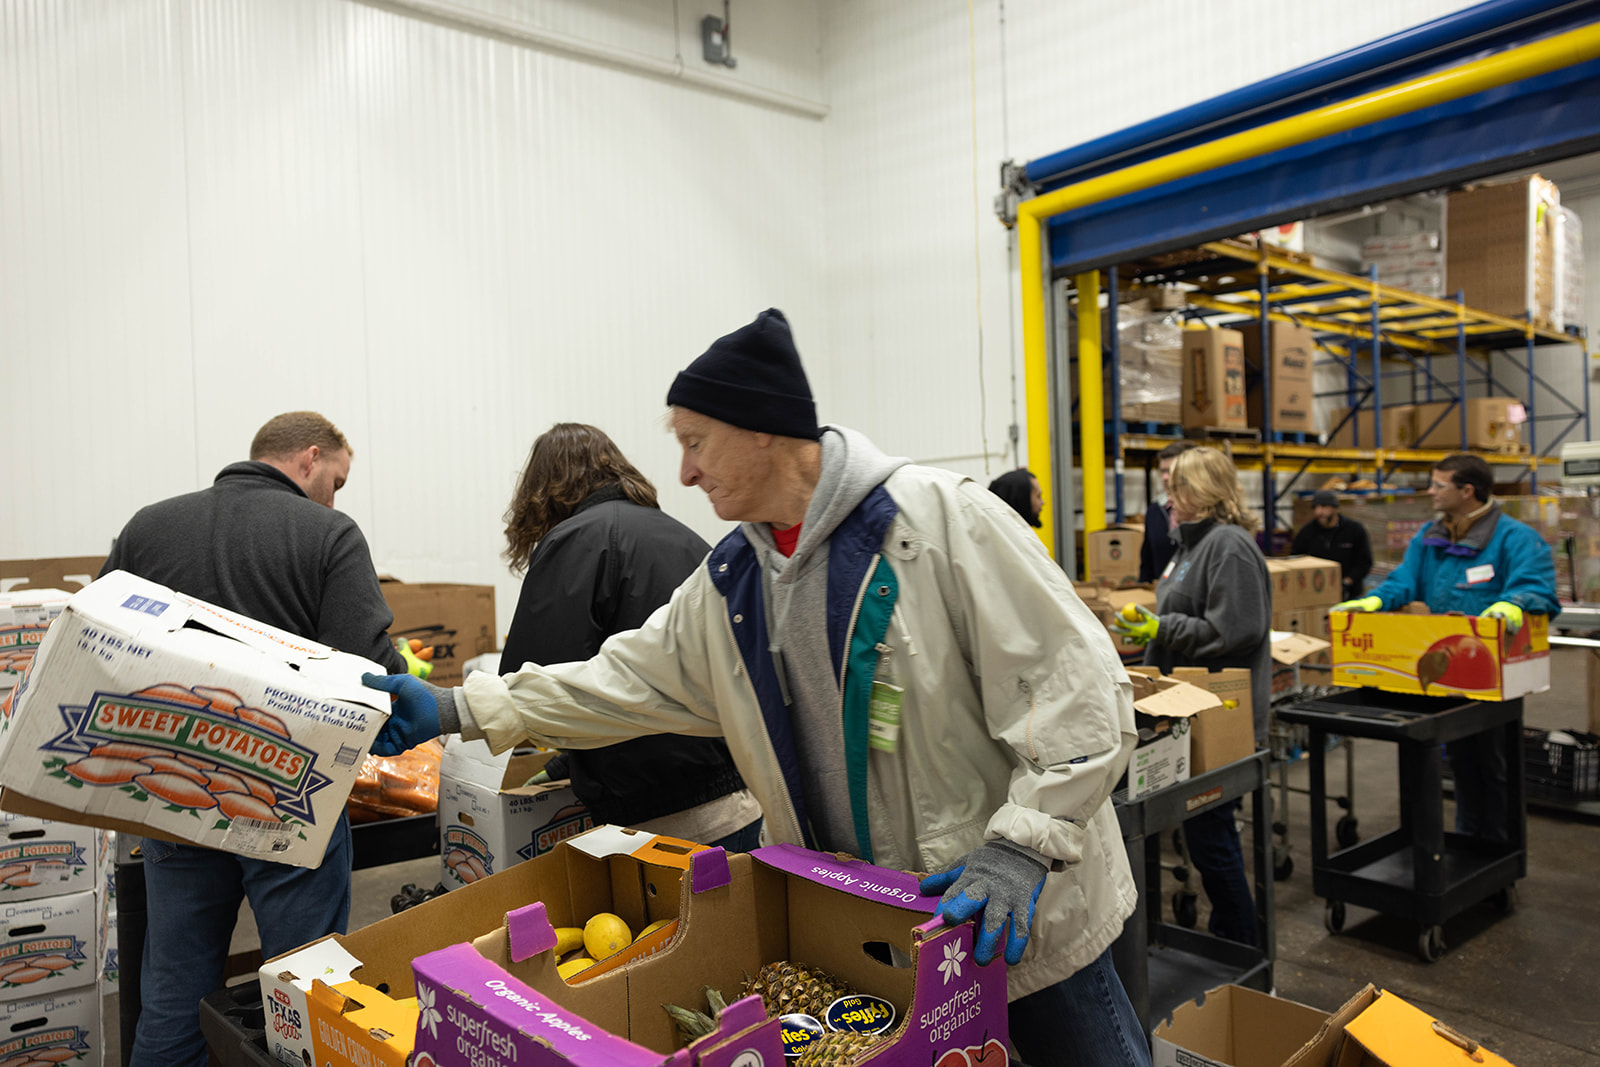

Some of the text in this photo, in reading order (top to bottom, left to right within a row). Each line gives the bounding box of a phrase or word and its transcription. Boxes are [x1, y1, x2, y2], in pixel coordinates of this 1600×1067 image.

[81, 626, 99, 640] 40
[127, 643, 153, 659] NET
[1342, 633, 1374, 651] Fuji
[264, 686, 368, 723] PRODUCT OF U.S.A.
[267, 698, 302, 715] Produit
[304, 709, 320, 721] des
[346, 720, 366, 732] Unis
[100, 703, 302, 776] SWEET POTATOES
[535, 794, 549, 802] NET
[24, 845, 70, 856] POTATOES
[539, 821, 580, 849] SWEET
[811, 866, 917, 903] Organic Apples
[24, 940, 70, 952] POTATOES
[267, 995, 302, 1029] TEXAS
[485, 979, 593, 1042] Organic Apples
[843, 998, 862, 1008] Gold
[920, 980, 981, 1030] superfresh
[26, 1029, 74, 1046] POTATOES
[317, 1018, 348, 1058] GOLDEN
[447, 1004, 517, 1062] superfresh
[930, 1001, 981, 1043] organics
